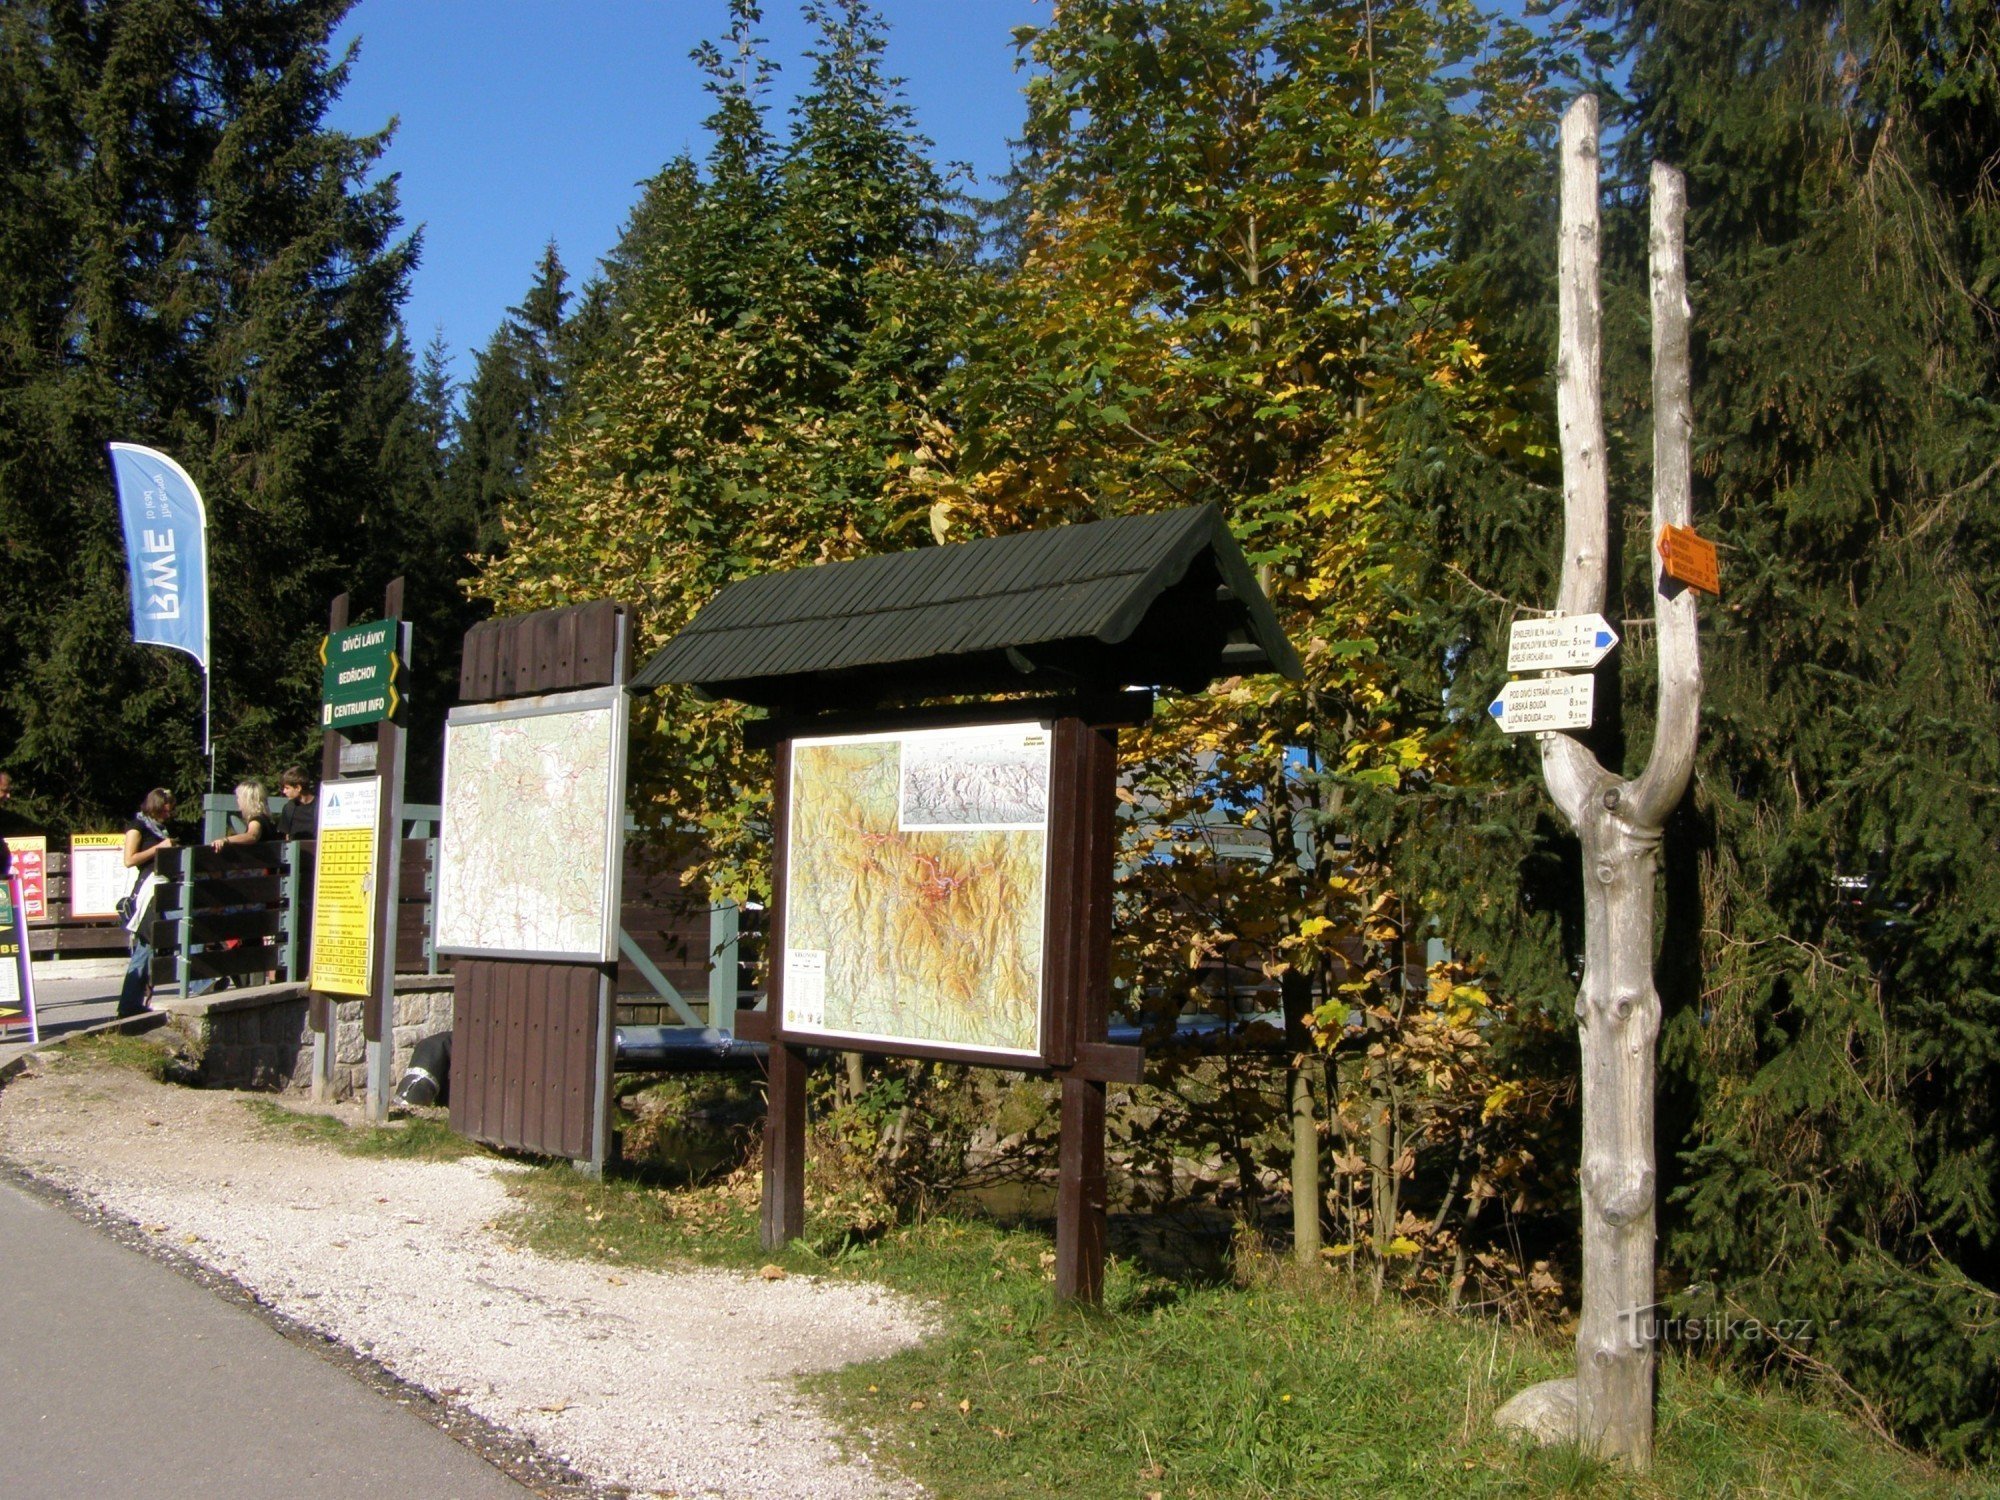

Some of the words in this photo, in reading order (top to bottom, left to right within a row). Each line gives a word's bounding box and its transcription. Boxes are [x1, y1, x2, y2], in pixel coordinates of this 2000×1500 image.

[1574, 625, 1578, 633] 1
[342, 634, 362, 652] DÍVČÍ
[362, 630, 386, 647] LÁVKY
[1568, 650, 1576, 658] 14
[338, 665, 377, 685] BEDŘICHOV
[1571, 685, 1574, 693] 1
[334, 700, 367, 718] CENTRUM
[368, 697, 385, 712] INFO
[1509, 702, 1528, 711] LABSKÁ
[1529, 700, 1546, 710] BOUDA
[1508, 713, 1523, 724] LUČNÍ
[1524, 713, 1541, 723] BOUDA
